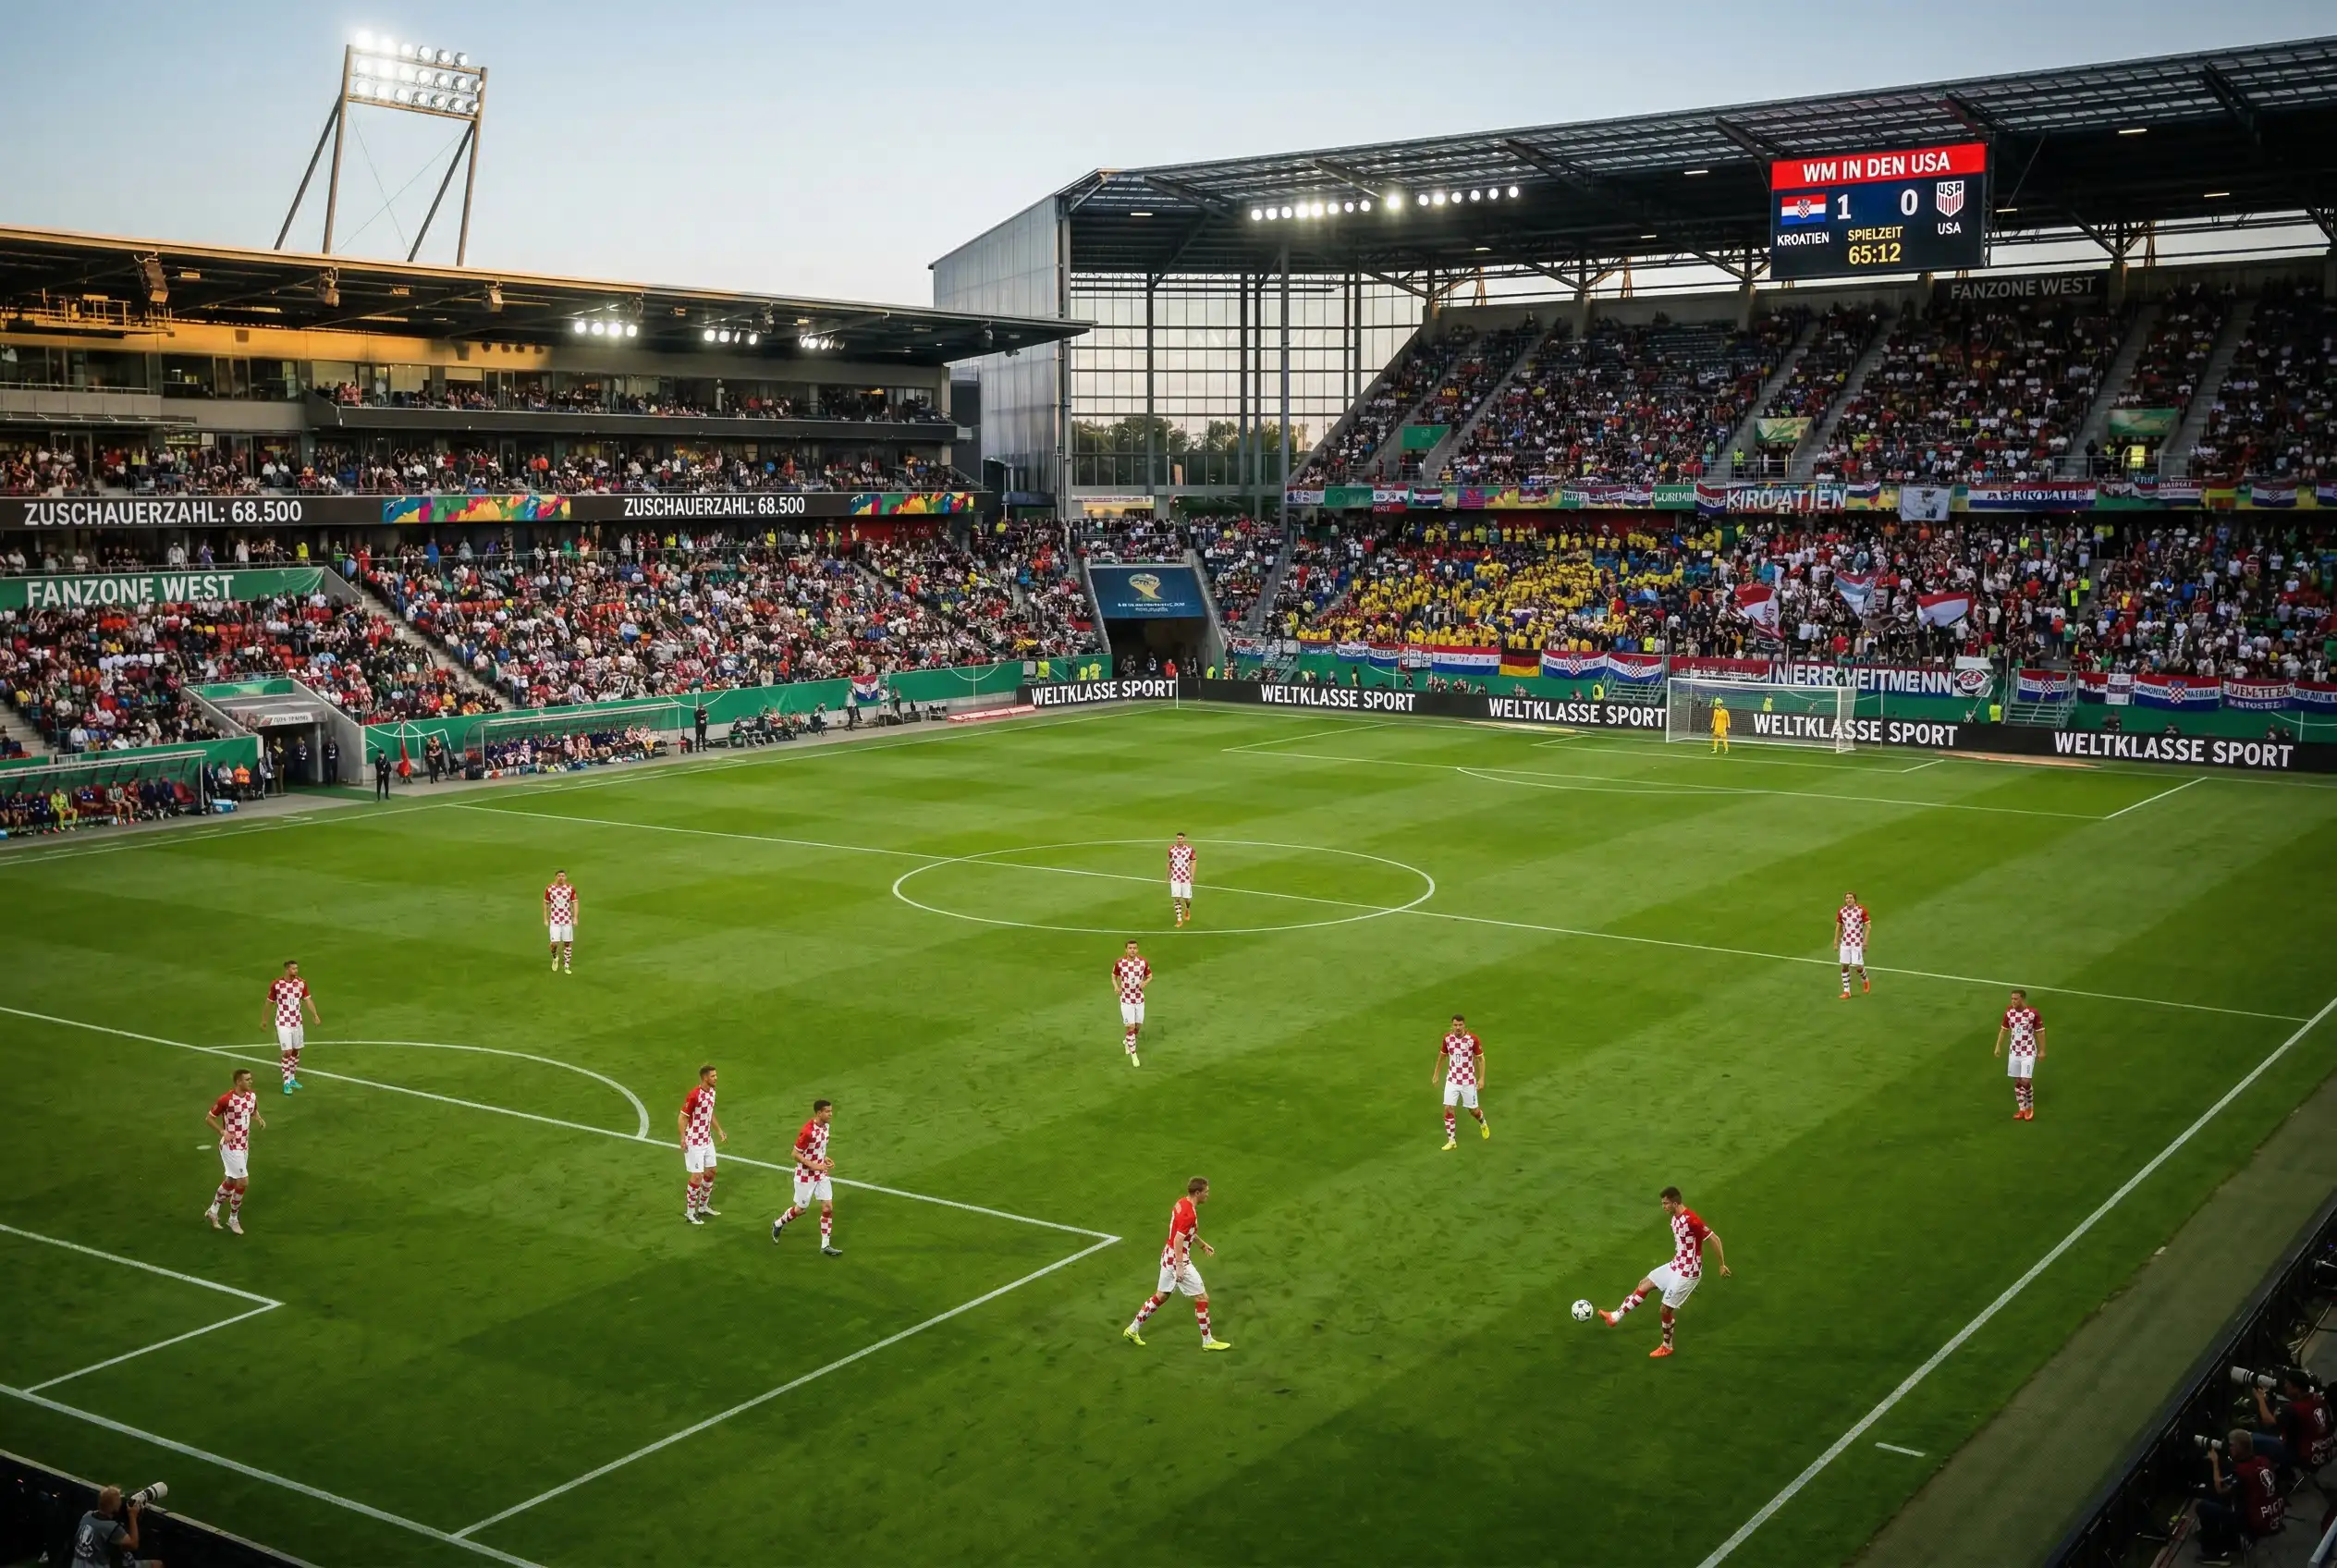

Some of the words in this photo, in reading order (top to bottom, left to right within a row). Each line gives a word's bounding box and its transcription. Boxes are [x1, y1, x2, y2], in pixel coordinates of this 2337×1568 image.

[1804, 163, 1837, 183] WM
[1842, 160, 1862, 179] IN
[1866, 155, 1905, 177] DEN
[1911, 152, 1951, 173] USA
[1837, 194, 1852, 220] 1
[1901, 189, 1918, 215] 0
[1777, 231, 1829, 246] KROATIEN
[1848, 226, 1903, 241] SPIELZEIT
[1938, 222, 1962, 235] USA
[1849, 242, 1902, 265] 65:12
[1951, 280, 2036, 300] FANZONE
[2041, 276, 2096, 295] WEST
[24, 502, 226, 526] ZUSCHAUERZAHL:
[231, 500, 302, 523] 68.500
[624, 496, 754, 517] ZUSCHAUERZAHL:
[758, 496, 805, 515] 68.500
[27, 578, 155, 606] FANZONE
[162, 575, 235, 602] WEST
[1032, 681, 1118, 705] WELTKLASSE
[1122, 680, 1176, 697] SPORT
[1260, 684, 1358, 708] WELTKLASSE
[1364, 691, 1416, 712] SPORT
[1488, 698, 1600, 724] WELTKLASSE
[1606, 705, 1666, 729] SPORT
[1753, 713, 1882, 741] WELTKLASSE
[1888, 721, 1959, 746] SPORT
[2054, 731, 2205, 763] WELTKLASSE
[2212, 740, 2294, 768] SPORT
